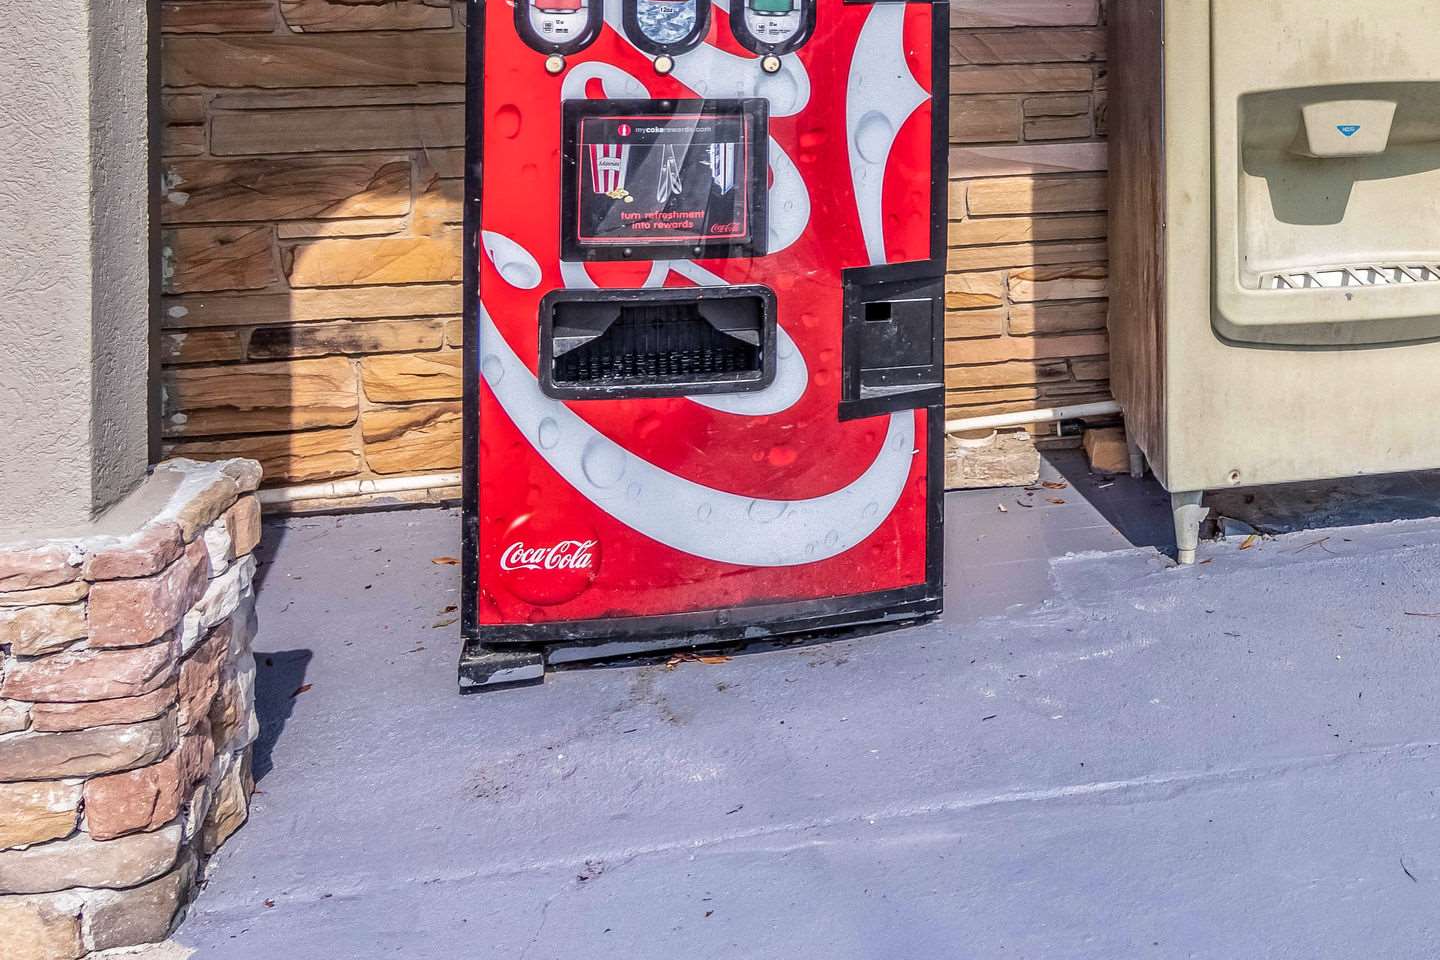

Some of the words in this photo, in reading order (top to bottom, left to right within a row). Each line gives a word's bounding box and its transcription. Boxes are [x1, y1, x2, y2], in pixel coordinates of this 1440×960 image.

[621, 212, 641, 220] turn
[645, 210, 704, 220] refreshment
[632, 221, 651, 230] into
[653, 220, 694, 229] rewards
[500, 540, 598, 571] Coca-Cola
